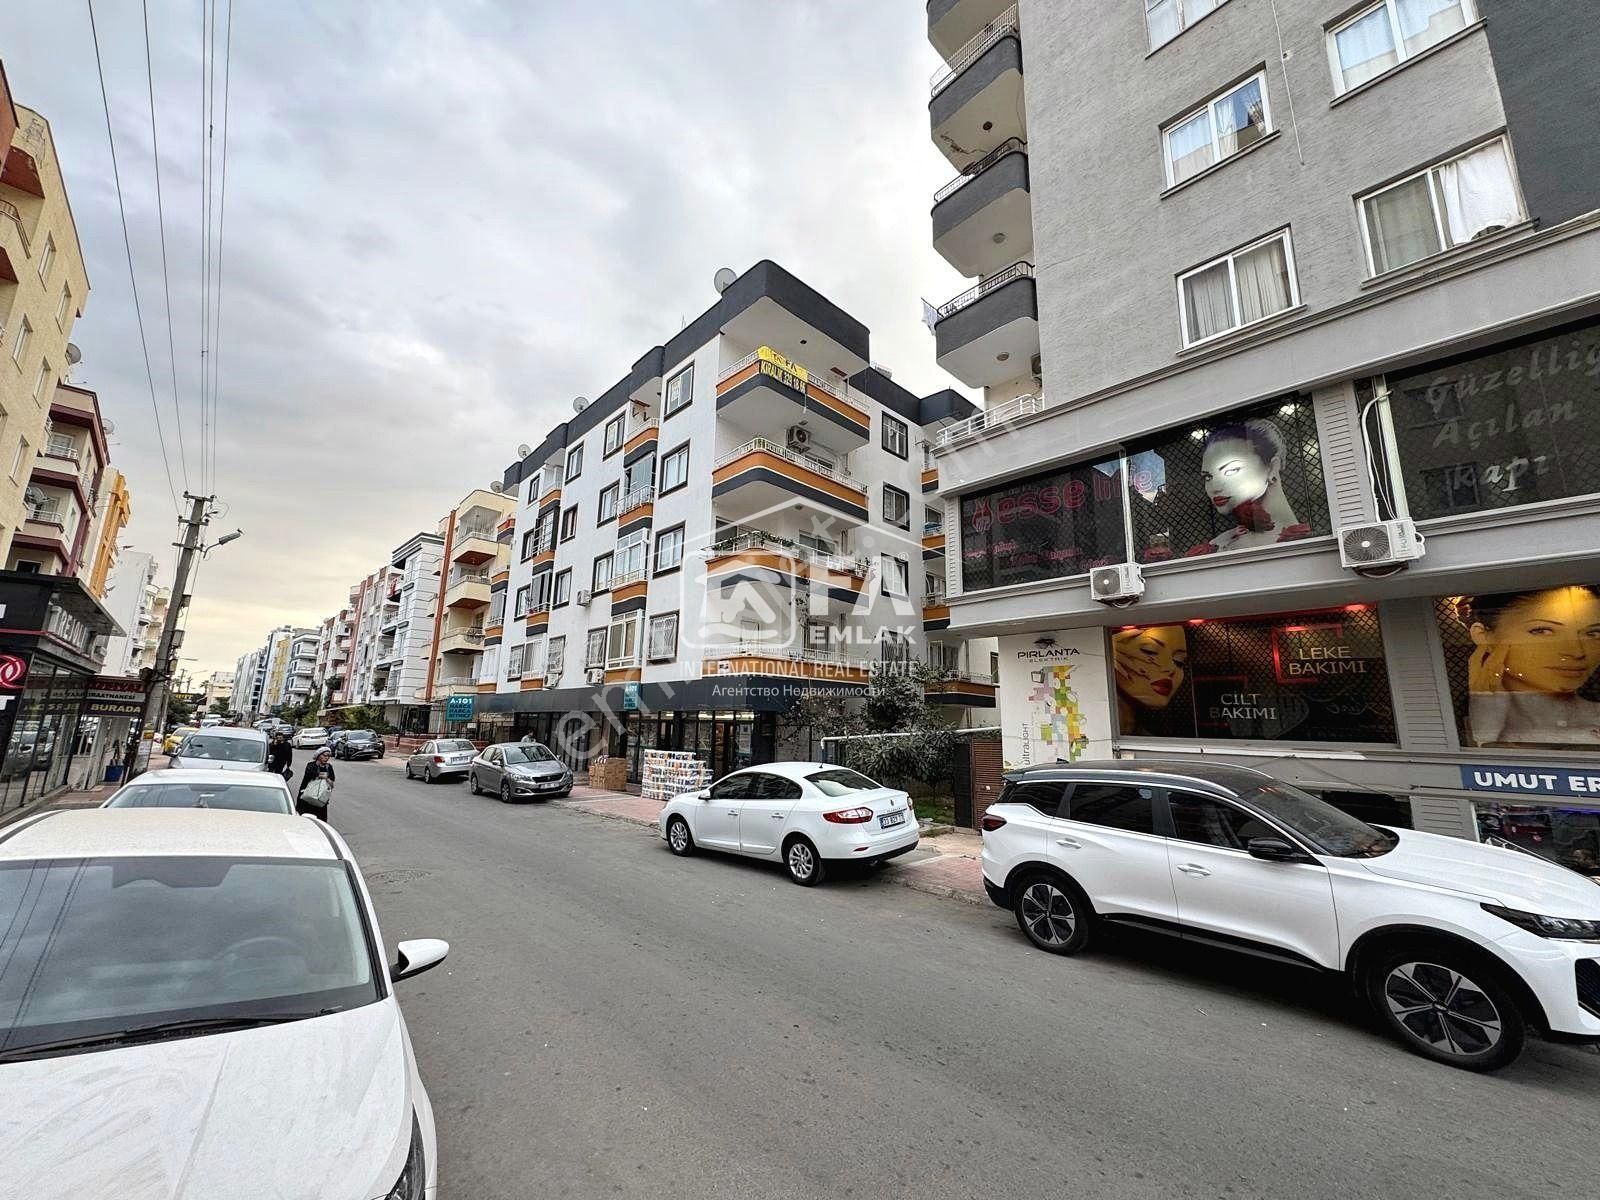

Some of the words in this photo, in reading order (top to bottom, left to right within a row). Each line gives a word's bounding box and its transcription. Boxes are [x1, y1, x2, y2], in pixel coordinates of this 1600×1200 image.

[1017, 648, 1080, 659] PIRLANTA
[1299, 645, 1352, 660] LEKE
[1288, 660, 1367, 675] BAKIMI
[91, 703, 141, 713] BURADA
[1208, 705, 1278, 720] BAKIMI
[1474, 771, 1557, 790] UMUT
